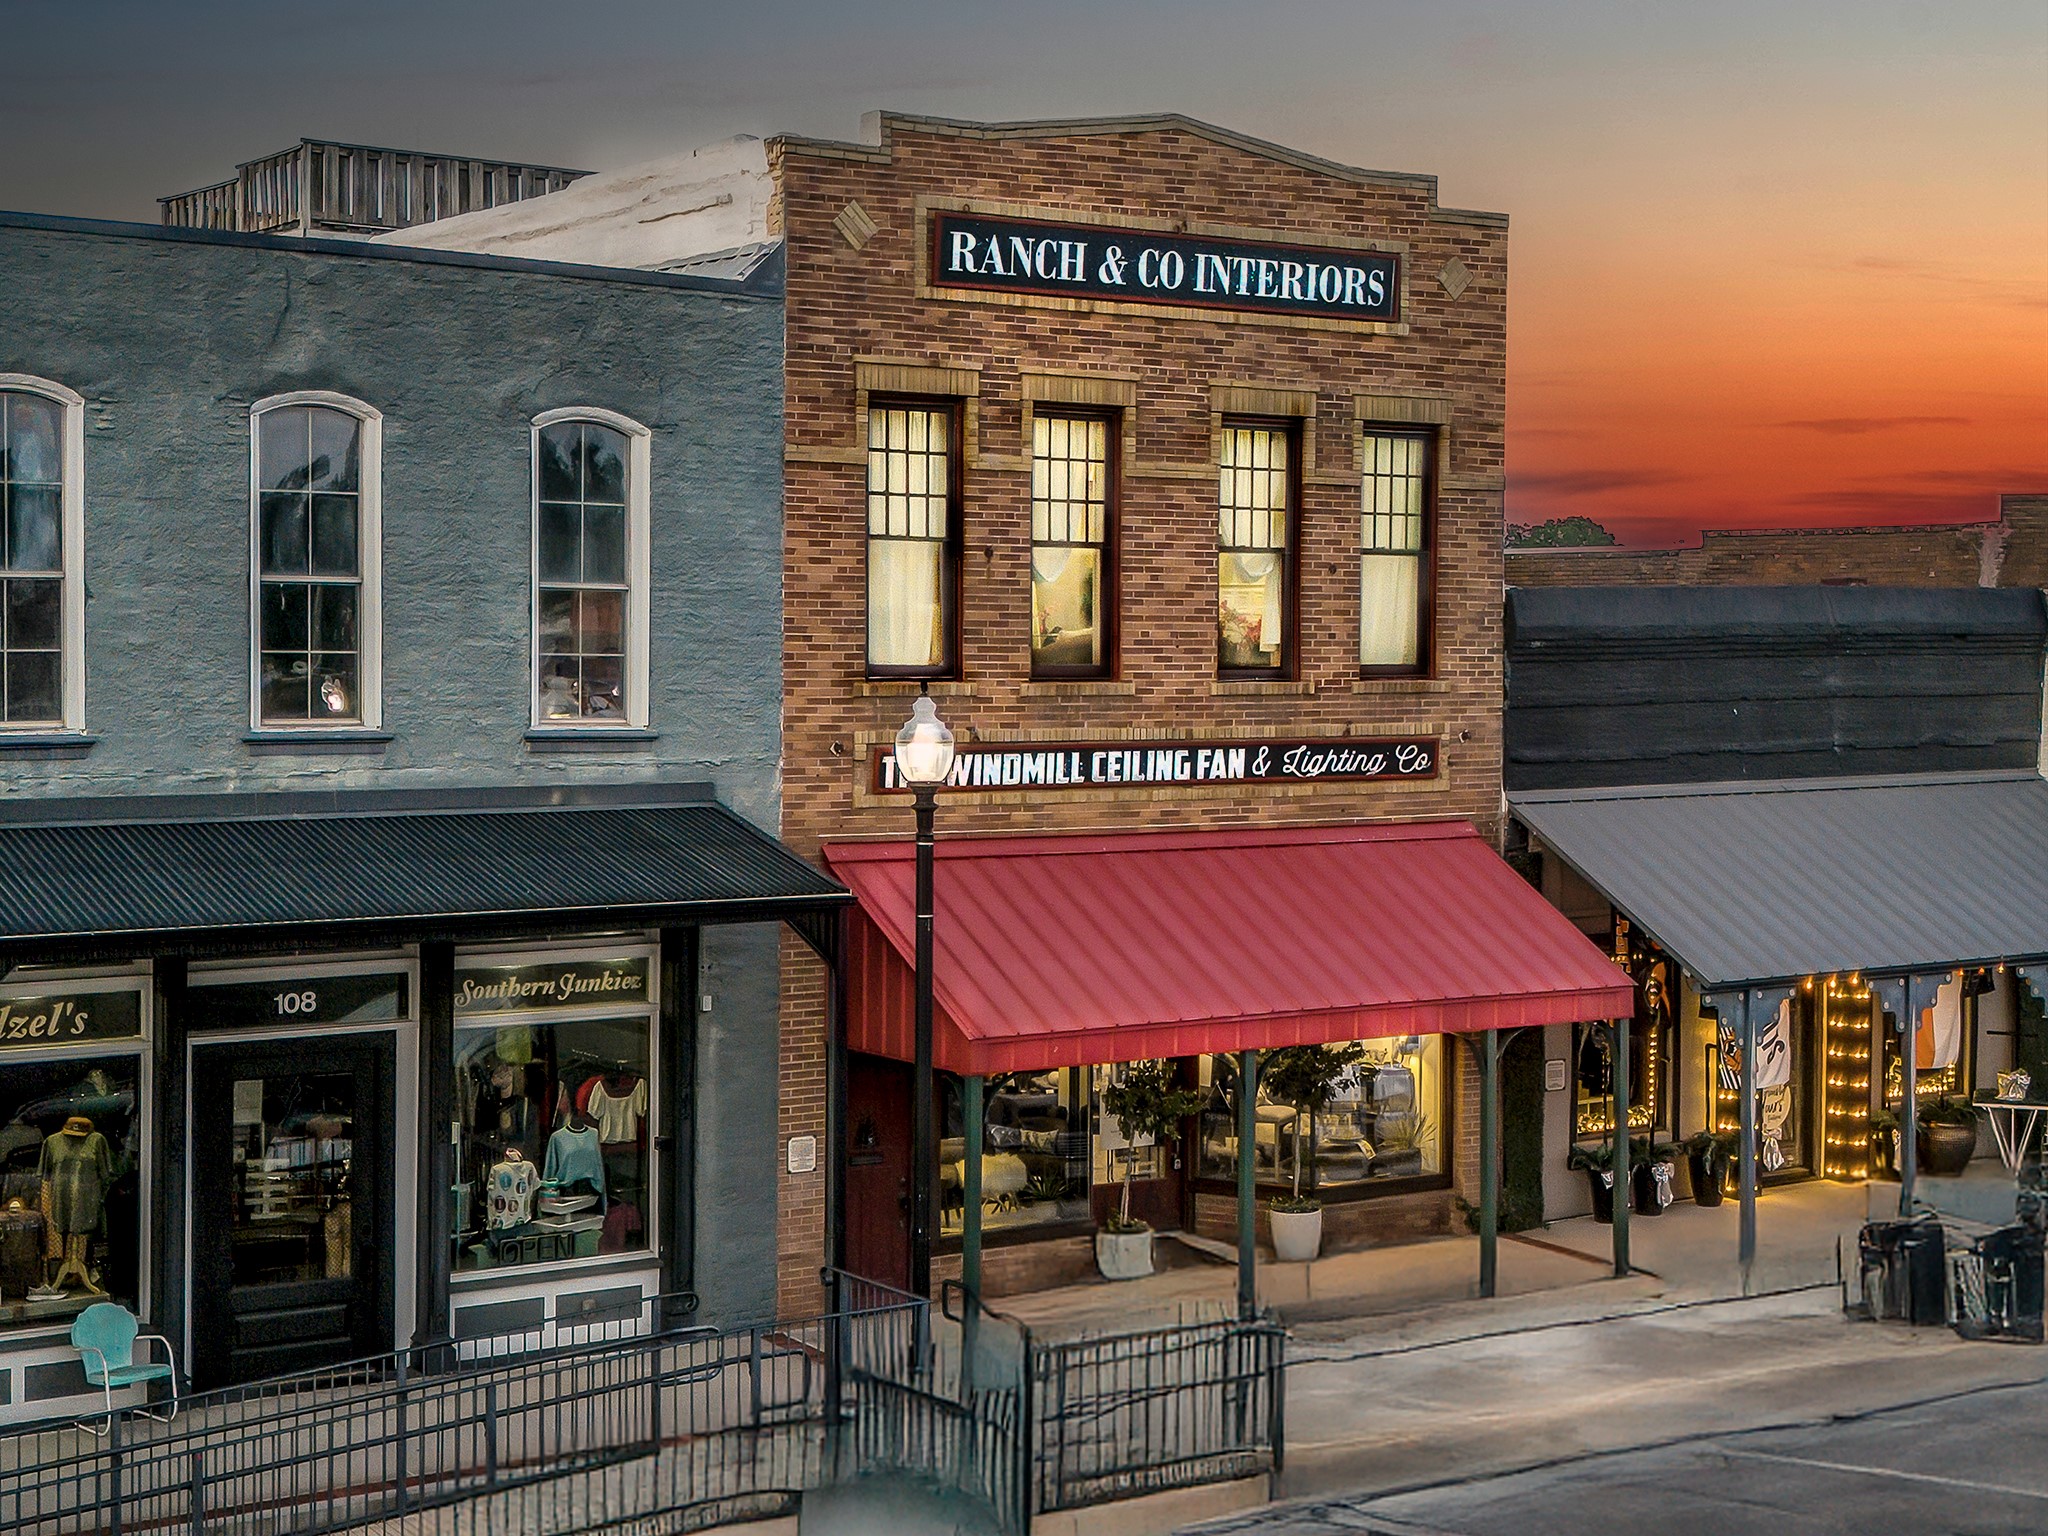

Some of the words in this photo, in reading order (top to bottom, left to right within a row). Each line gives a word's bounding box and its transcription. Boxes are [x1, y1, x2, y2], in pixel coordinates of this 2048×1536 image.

[948, 230, 1088, 283] RANCH
[1098, 245, 1127, 287] &
[1138, 248, 1185, 291] CO
[1194, 252, 1386, 307] INTERIORS
[947, 751, 1085, 787] WINDMILL
[1091, 749, 1191, 784] CEILING
[1197, 748, 1246, 781] FAN
[1252, 745, 1272, 778] &
[1282, 744, 1388, 778] Lighting
[1395, 744, 1432, 774] Co
[273, 991, 317, 1015] 108
[454, 976, 556, 1008] Southern
[557, 969, 642, 1001] Junkiez
[500, 1232, 575, 1264] OPEN
